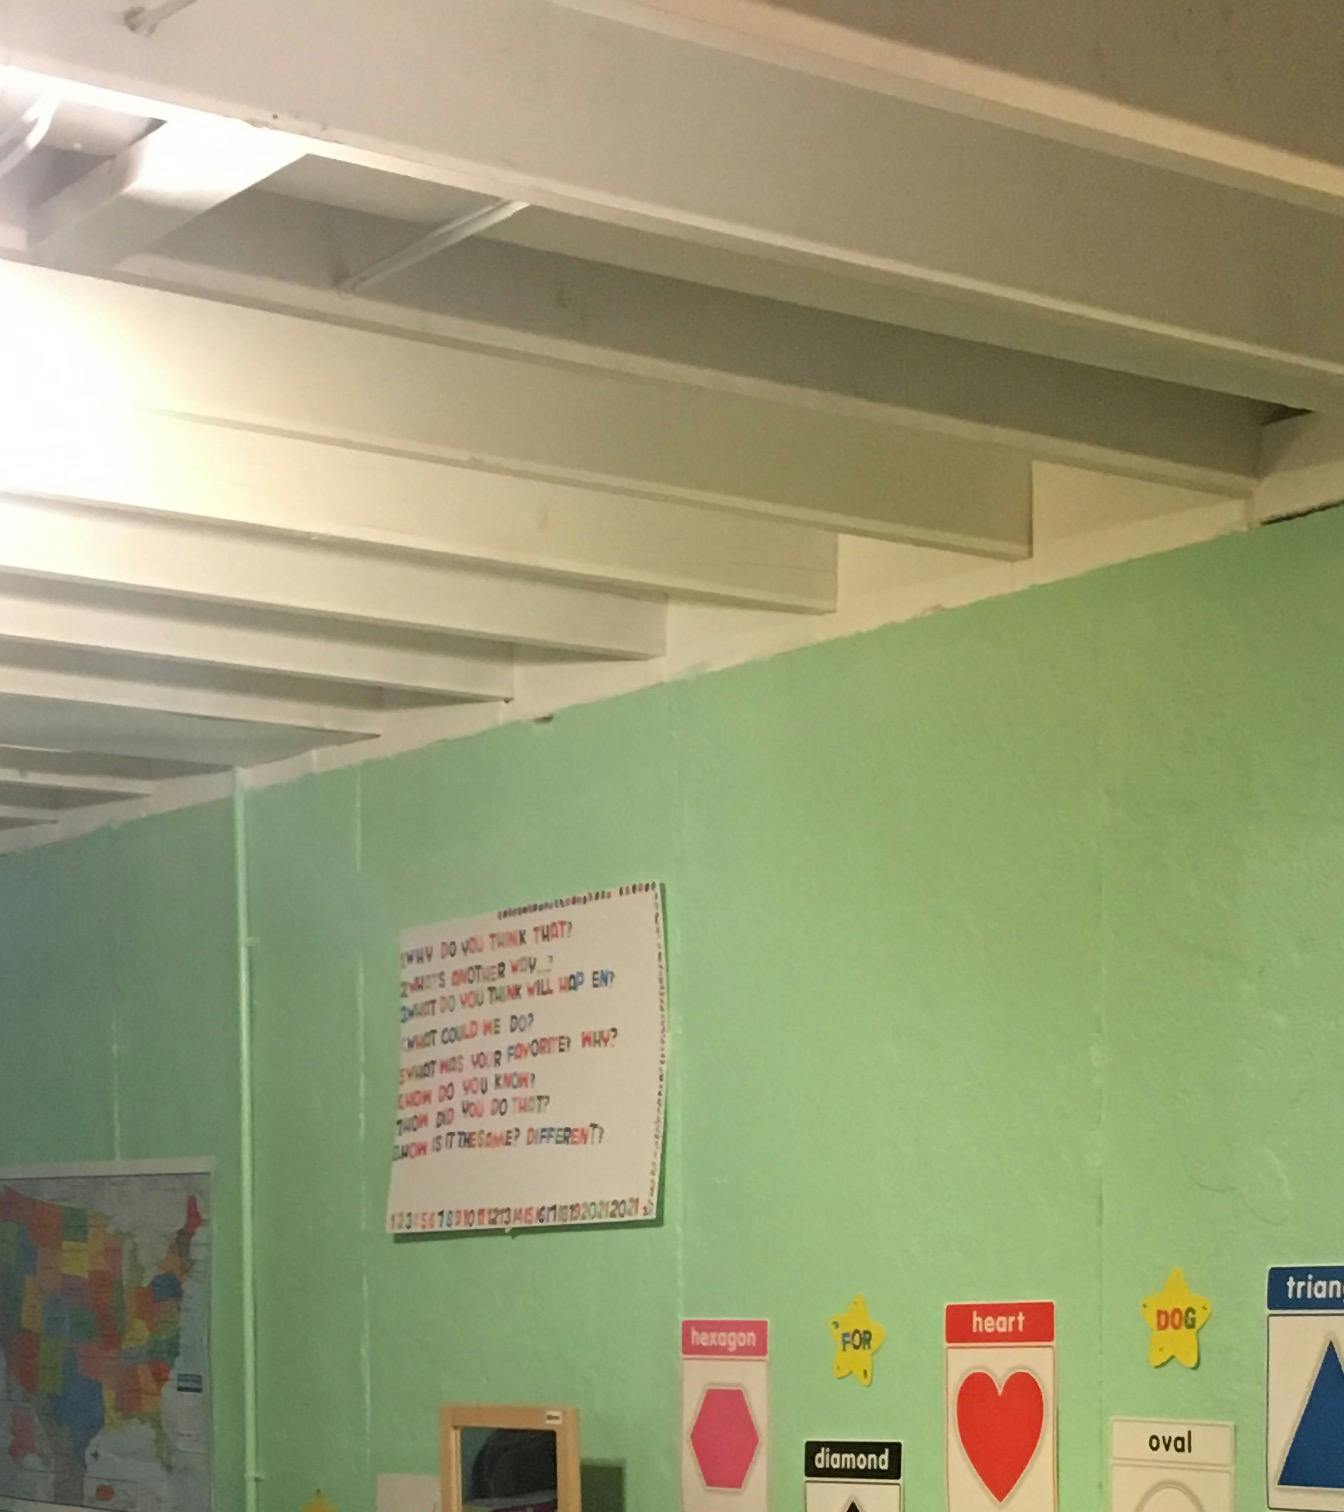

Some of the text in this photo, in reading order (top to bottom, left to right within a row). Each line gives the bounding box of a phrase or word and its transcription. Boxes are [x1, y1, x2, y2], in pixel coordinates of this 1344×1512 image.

[971, 1310, 1025, 1334] heart
[1156, 1307, 1197, 1332] DOG
[690, 1326, 757, 1352] hexagon
[841, 1328, 872, 1352] FOR
[1148, 1430, 1193, 1454] oval
[814, 1447, 890, 1472] diamond
